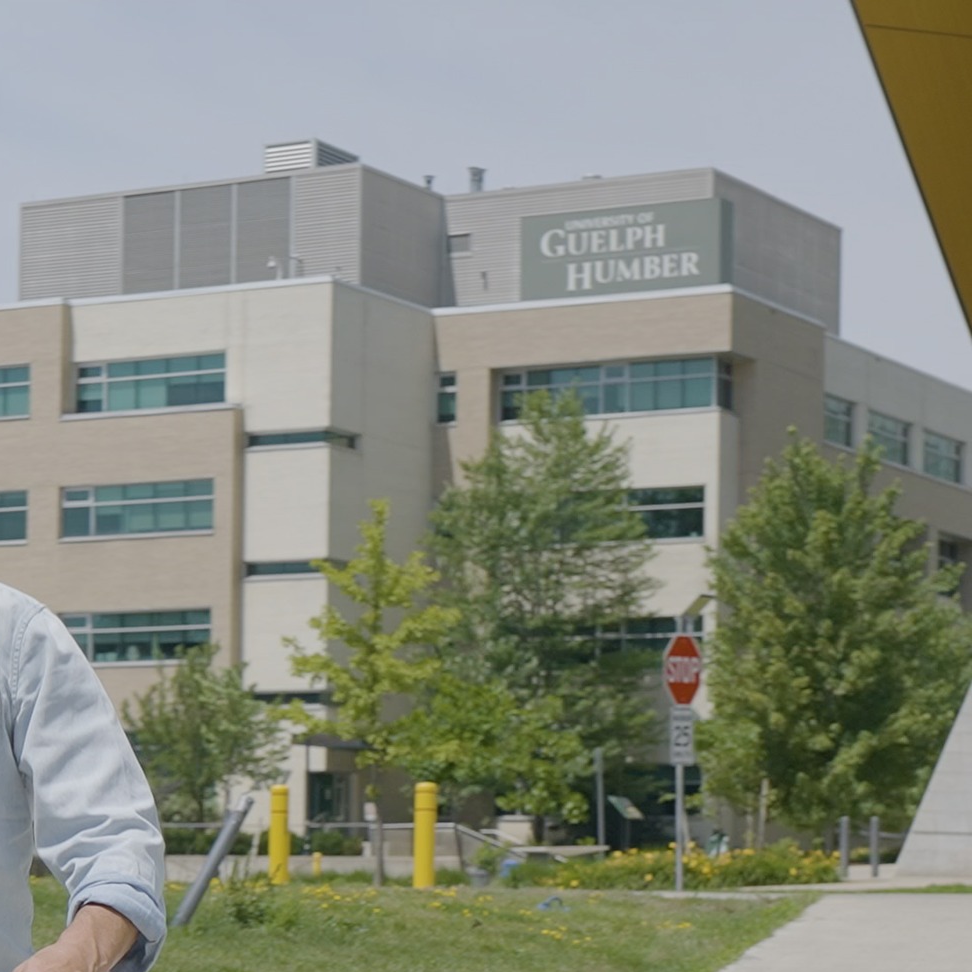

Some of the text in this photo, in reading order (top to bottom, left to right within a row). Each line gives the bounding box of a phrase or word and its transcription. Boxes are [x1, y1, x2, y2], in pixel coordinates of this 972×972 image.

[565, 211, 654, 230] UNIVERSITY OF
[566, 252, 699, 291] HUMBER
[666, 656, 700, 683] STOP
[674, 726, 690, 747] 25
